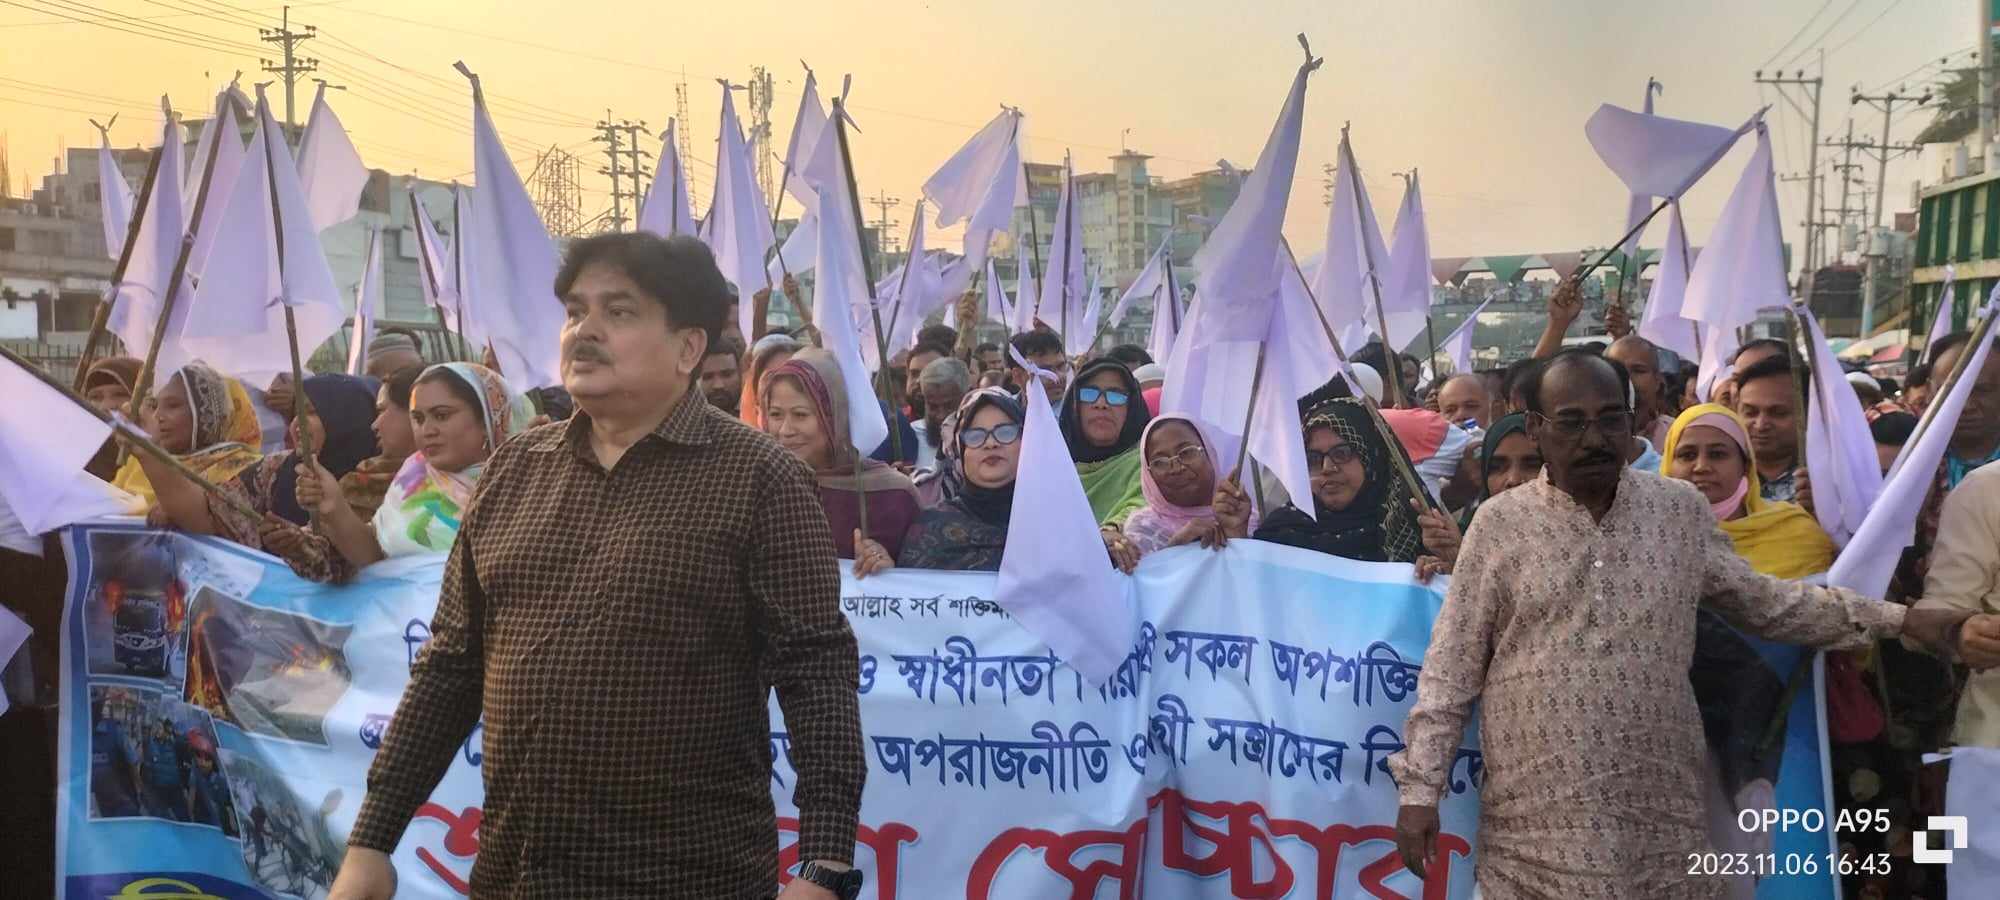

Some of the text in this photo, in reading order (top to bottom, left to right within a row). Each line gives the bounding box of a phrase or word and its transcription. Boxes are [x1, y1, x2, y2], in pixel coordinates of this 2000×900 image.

[843, 593, 1011, 620] আল্লাহ সর্ব শক্তিম
[890, 635, 1062, 706] স্বাধীনতা
[1164, 630, 1259, 687] সকল
[870, 720, 1112, 793] অপরাজনীতি
[1204, 717, 1349, 785] সন্ত্রাসের
